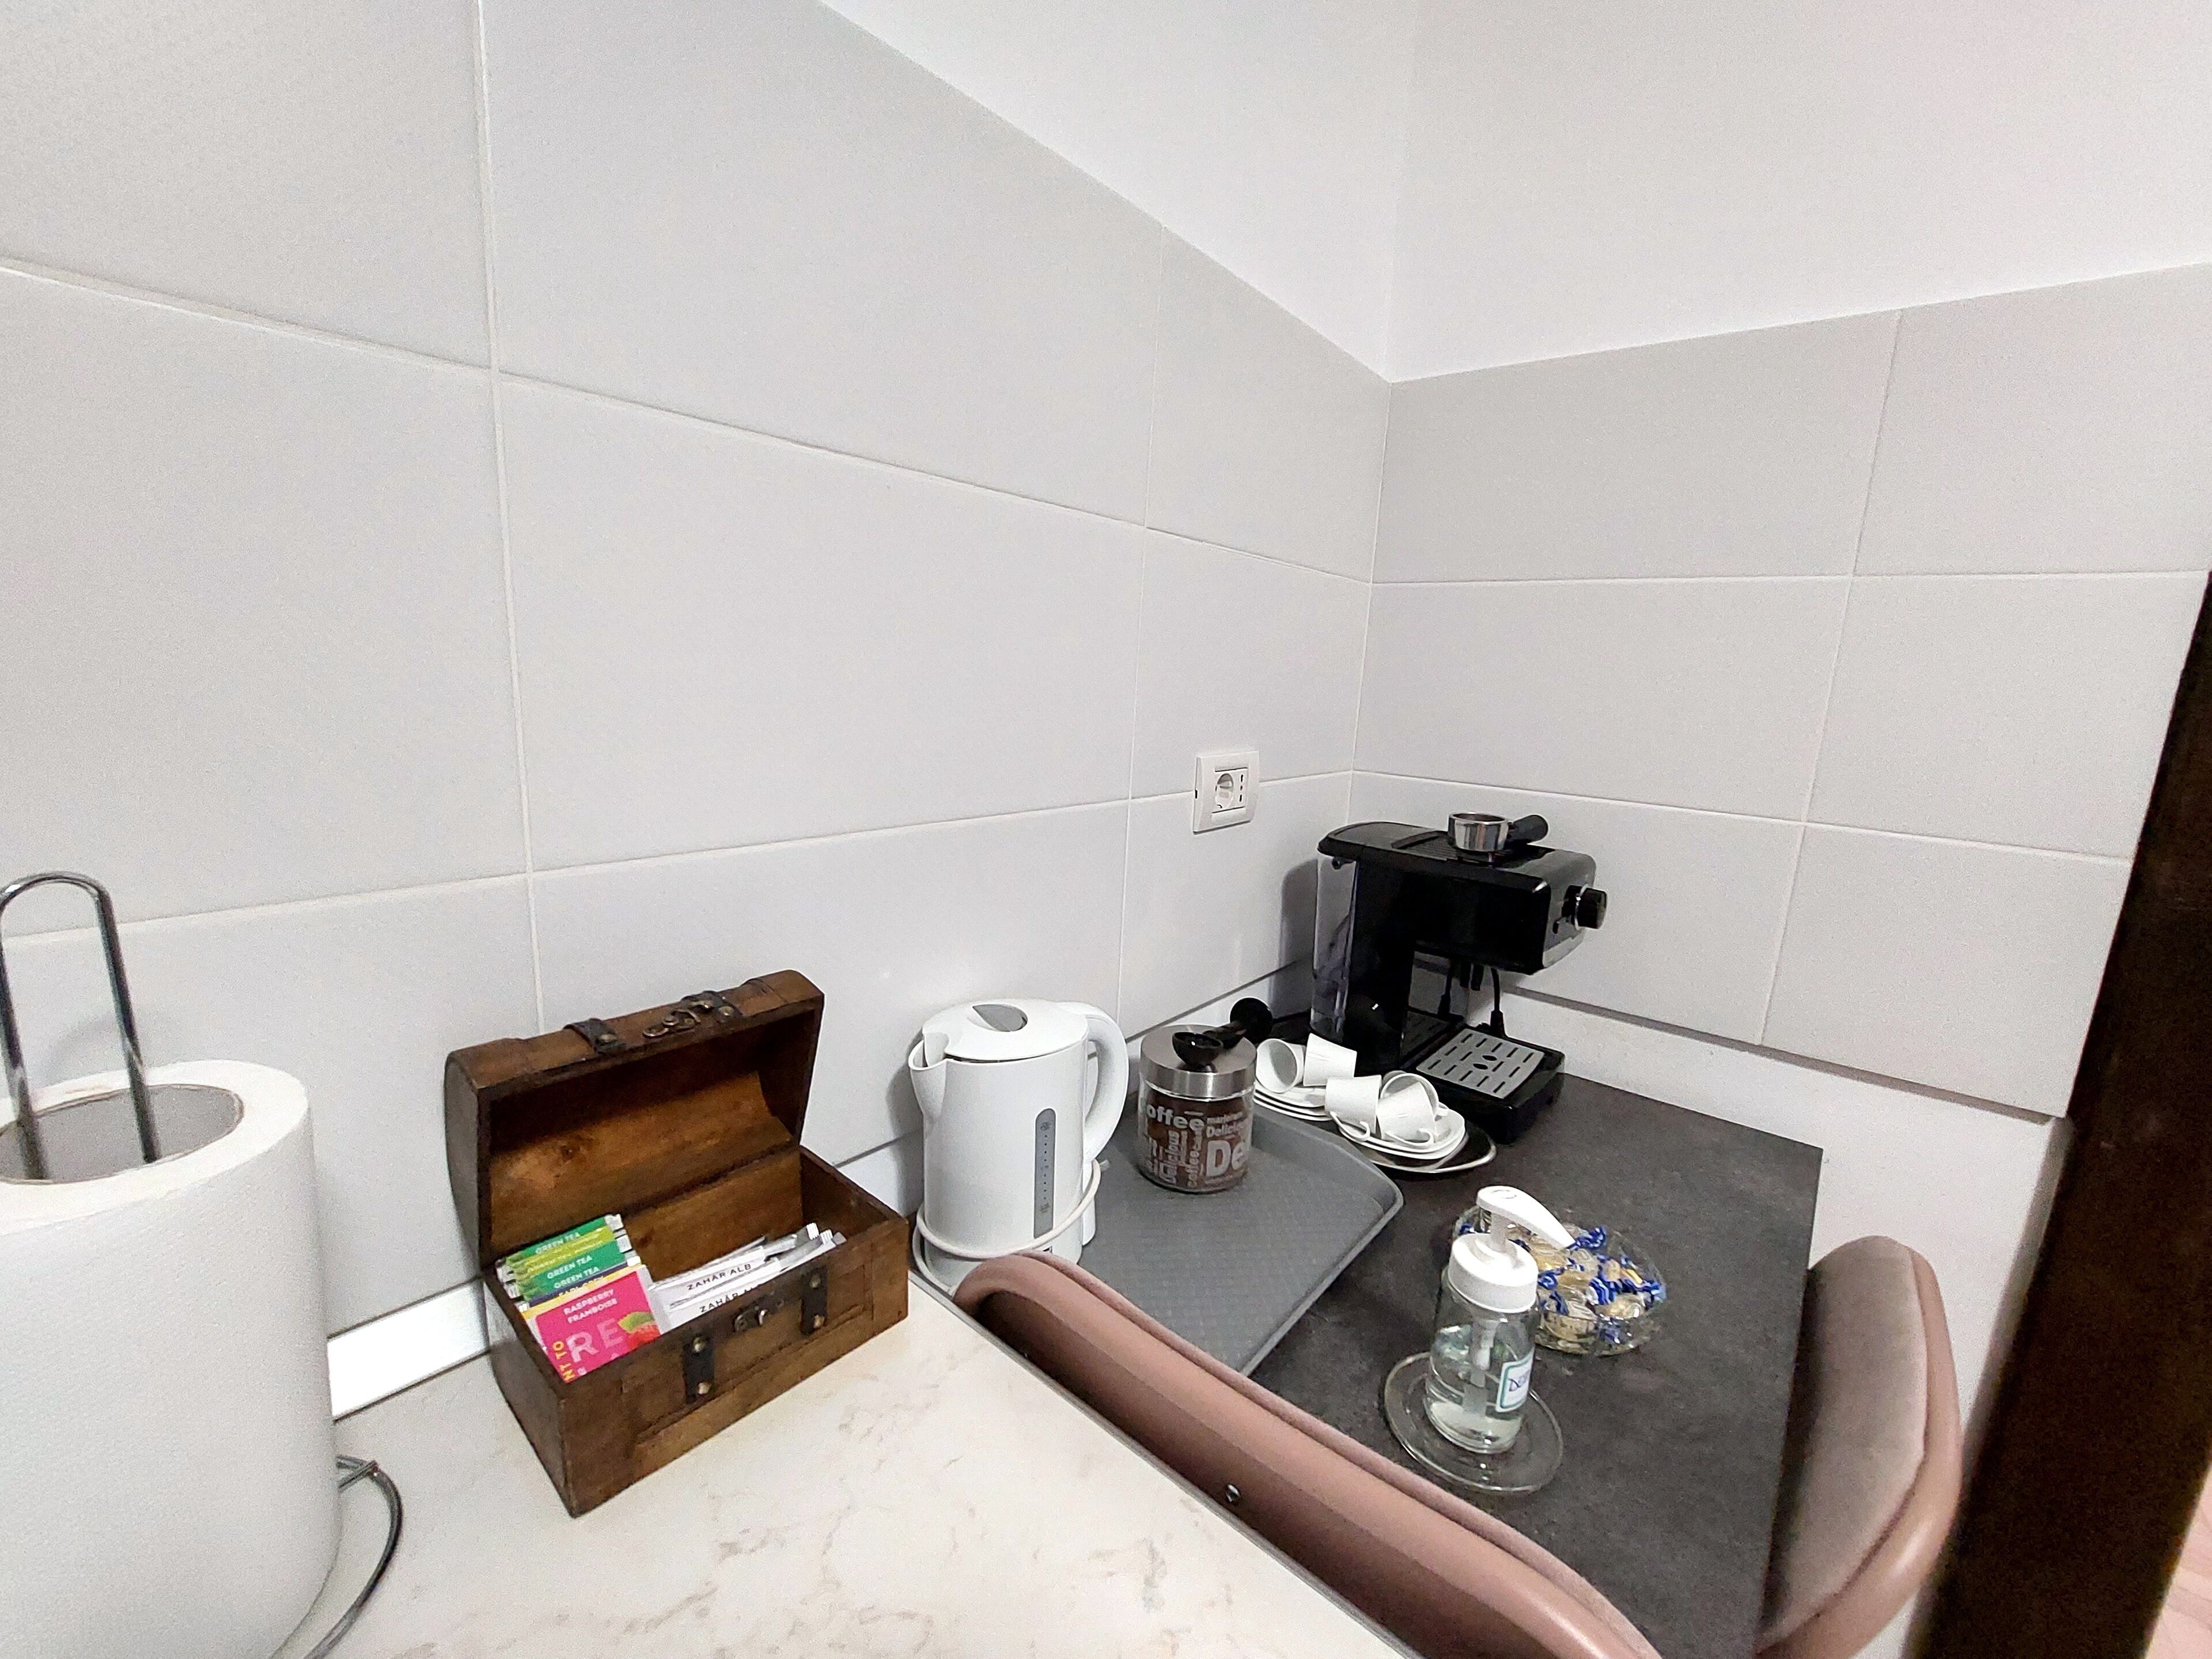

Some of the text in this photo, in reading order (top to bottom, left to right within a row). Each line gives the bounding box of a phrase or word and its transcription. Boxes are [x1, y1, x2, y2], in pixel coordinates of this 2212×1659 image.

[536, 1239, 564, 1254] GREEN
[564, 1232, 581, 1243] TEA
[547, 1262, 575, 1279] GREEN
[577, 1255, 593, 1266] TEA
[554, 1272, 583, 1289] GREEN
[584, 1266, 601, 1278] TEA
[730, 1263, 751, 1275] ALB
[563, 1288, 615, 1316] RASPBERRY
[552, 1340, 567, 1360] TO
